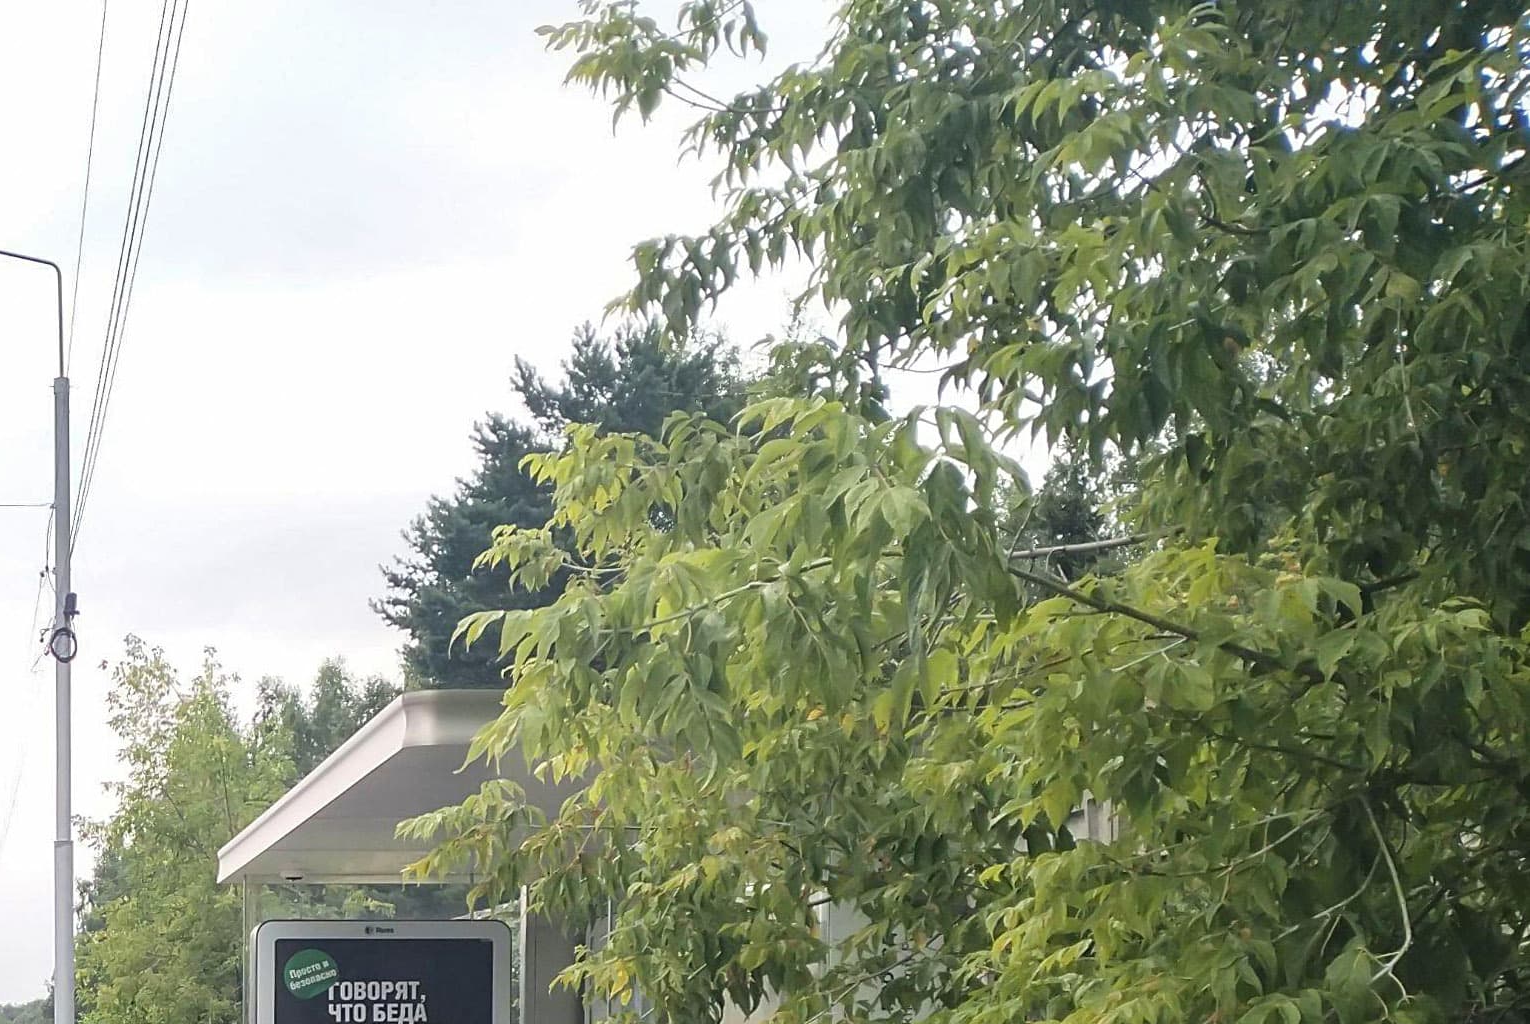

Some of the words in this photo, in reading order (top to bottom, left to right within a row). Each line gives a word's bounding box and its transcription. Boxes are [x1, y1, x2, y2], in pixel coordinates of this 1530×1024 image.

[289, 963, 322, 979] Просто
[322, 960, 330, 968] и
[289, 968, 338, 990] безопасно
[328, 981, 427, 1003] ГОВОРЯТ,
[328, 1003, 367, 1022] ЧТО
[373, 1003, 427, 1024] БЕДА
